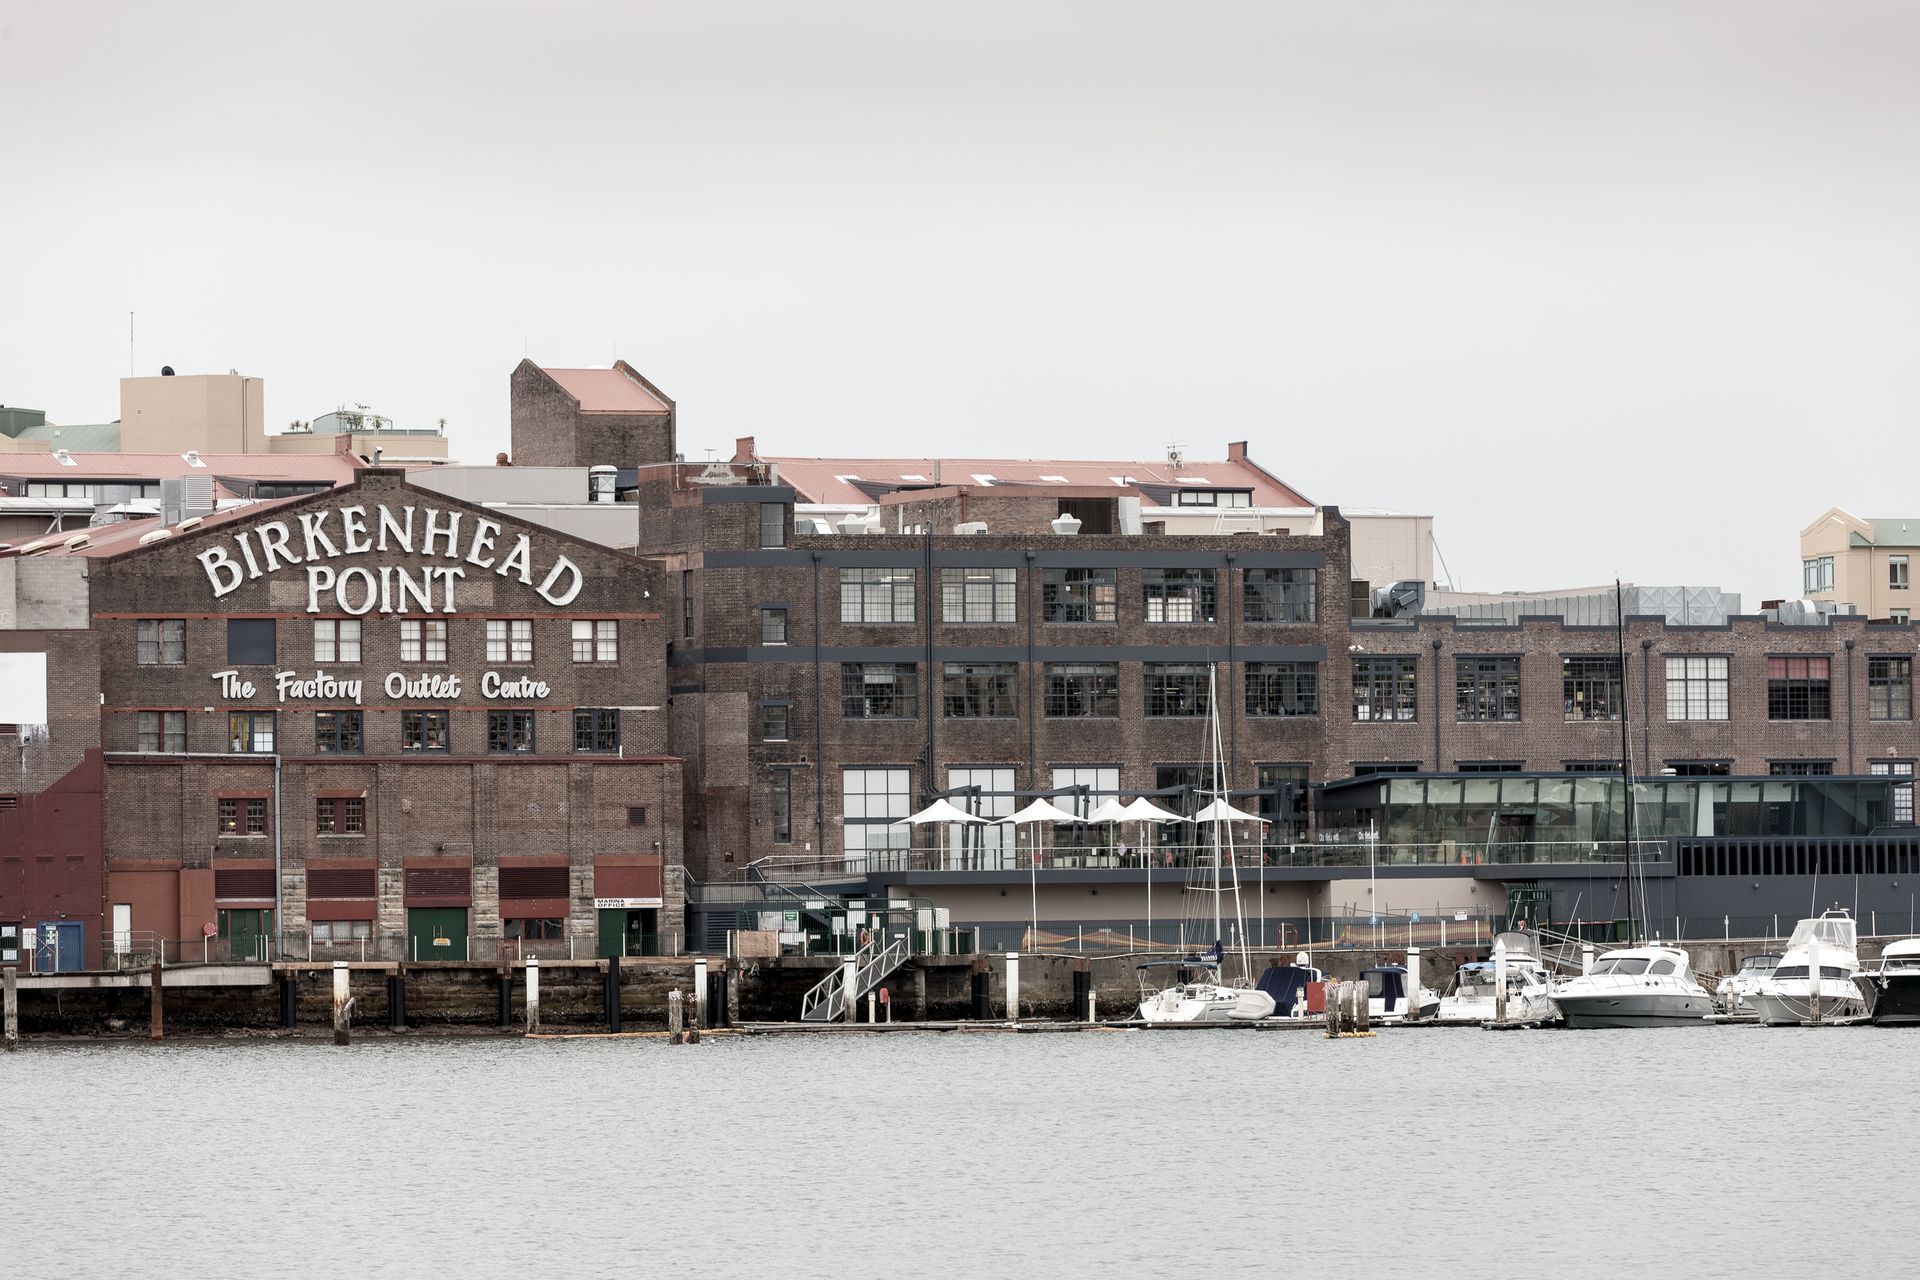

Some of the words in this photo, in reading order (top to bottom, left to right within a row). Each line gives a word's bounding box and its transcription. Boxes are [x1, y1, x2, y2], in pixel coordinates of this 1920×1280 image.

[196, 503, 584, 607] BIRKENHEAD
[305, 565, 466, 616] POINT
[212, 670, 257, 699] The
[275, 670, 363, 705] Factory
[384, 671, 462, 699] Outlet
[481, 671, 551, 699] Centre
